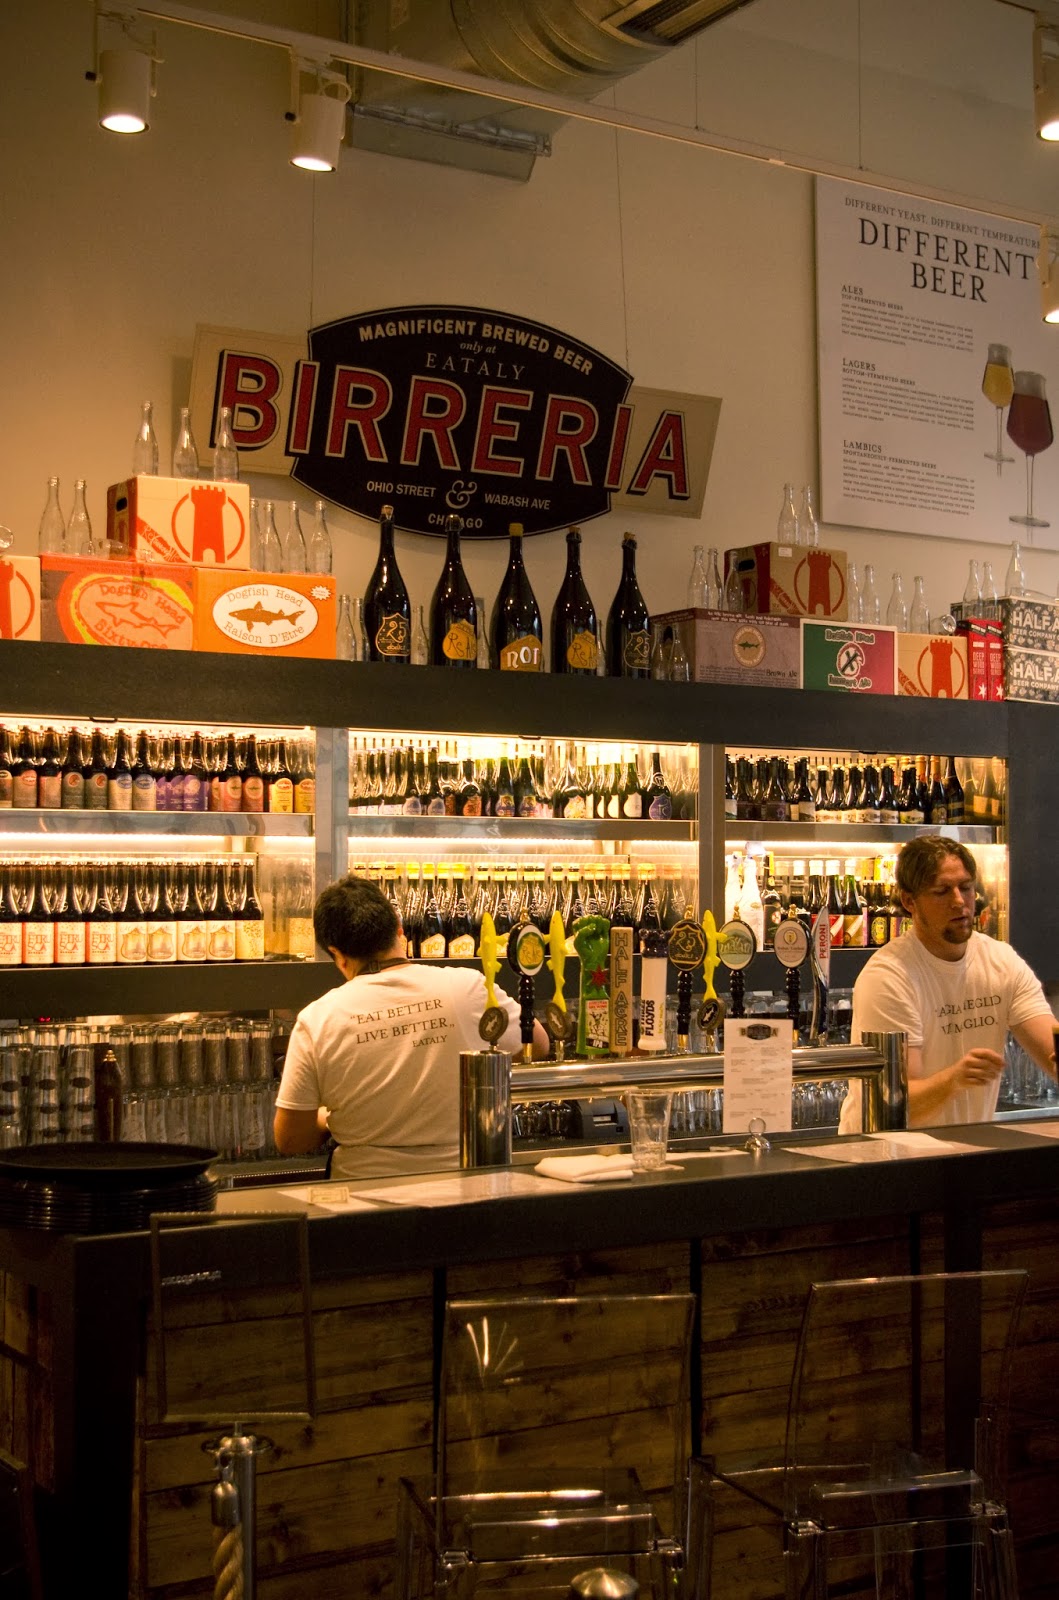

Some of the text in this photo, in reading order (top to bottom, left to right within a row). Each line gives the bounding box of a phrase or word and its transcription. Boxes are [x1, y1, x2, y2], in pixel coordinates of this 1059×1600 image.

[845, 197, 895, 217] DIFFERENT
[931, 216, 979, 235] DIFFERENT
[858, 217, 1035, 281] DIFFERENT
[841, 284, 865, 297] ALES
[910, 262, 988, 304] BEER
[358, 320, 593, 377] MAGNIFICENT BREWED BEER
[459, 341, 497, 355] only at
[425, 353, 527, 382] EATALY
[842, 358, 876, 372] LAGERS
[209, 350, 691, 502] BIRRERIA
[843, 439, 882, 454] LAMBICS
[366, 480, 551, 511] OHIO STREET & WABASH AVE
[427, 513, 483, 529] CHAGO
[226, 586, 269, 604] Dogfish
[275, 588, 304, 607] Head
[155, 596, 187, 624] Head
[1012, 610, 1051, 631] HALF
[223, 621, 263, 644] Raison
[1012, 627, 1028, 637] BEER
[1028, 630, 1056, 641] COMPANY
[1013, 662, 1052, 682] HALF
[1012, 679, 1030, 687] BEER
[676, 931, 696, 952] 25
[615, 932, 628, 1047] HALF ACRE
[388, 998, 443, 1019] BETTER
[645, 999, 655, 1037] FLOYDS
[356, 1028, 388, 1044] LIVE
[412, 1034, 448, 1048] EATALY
